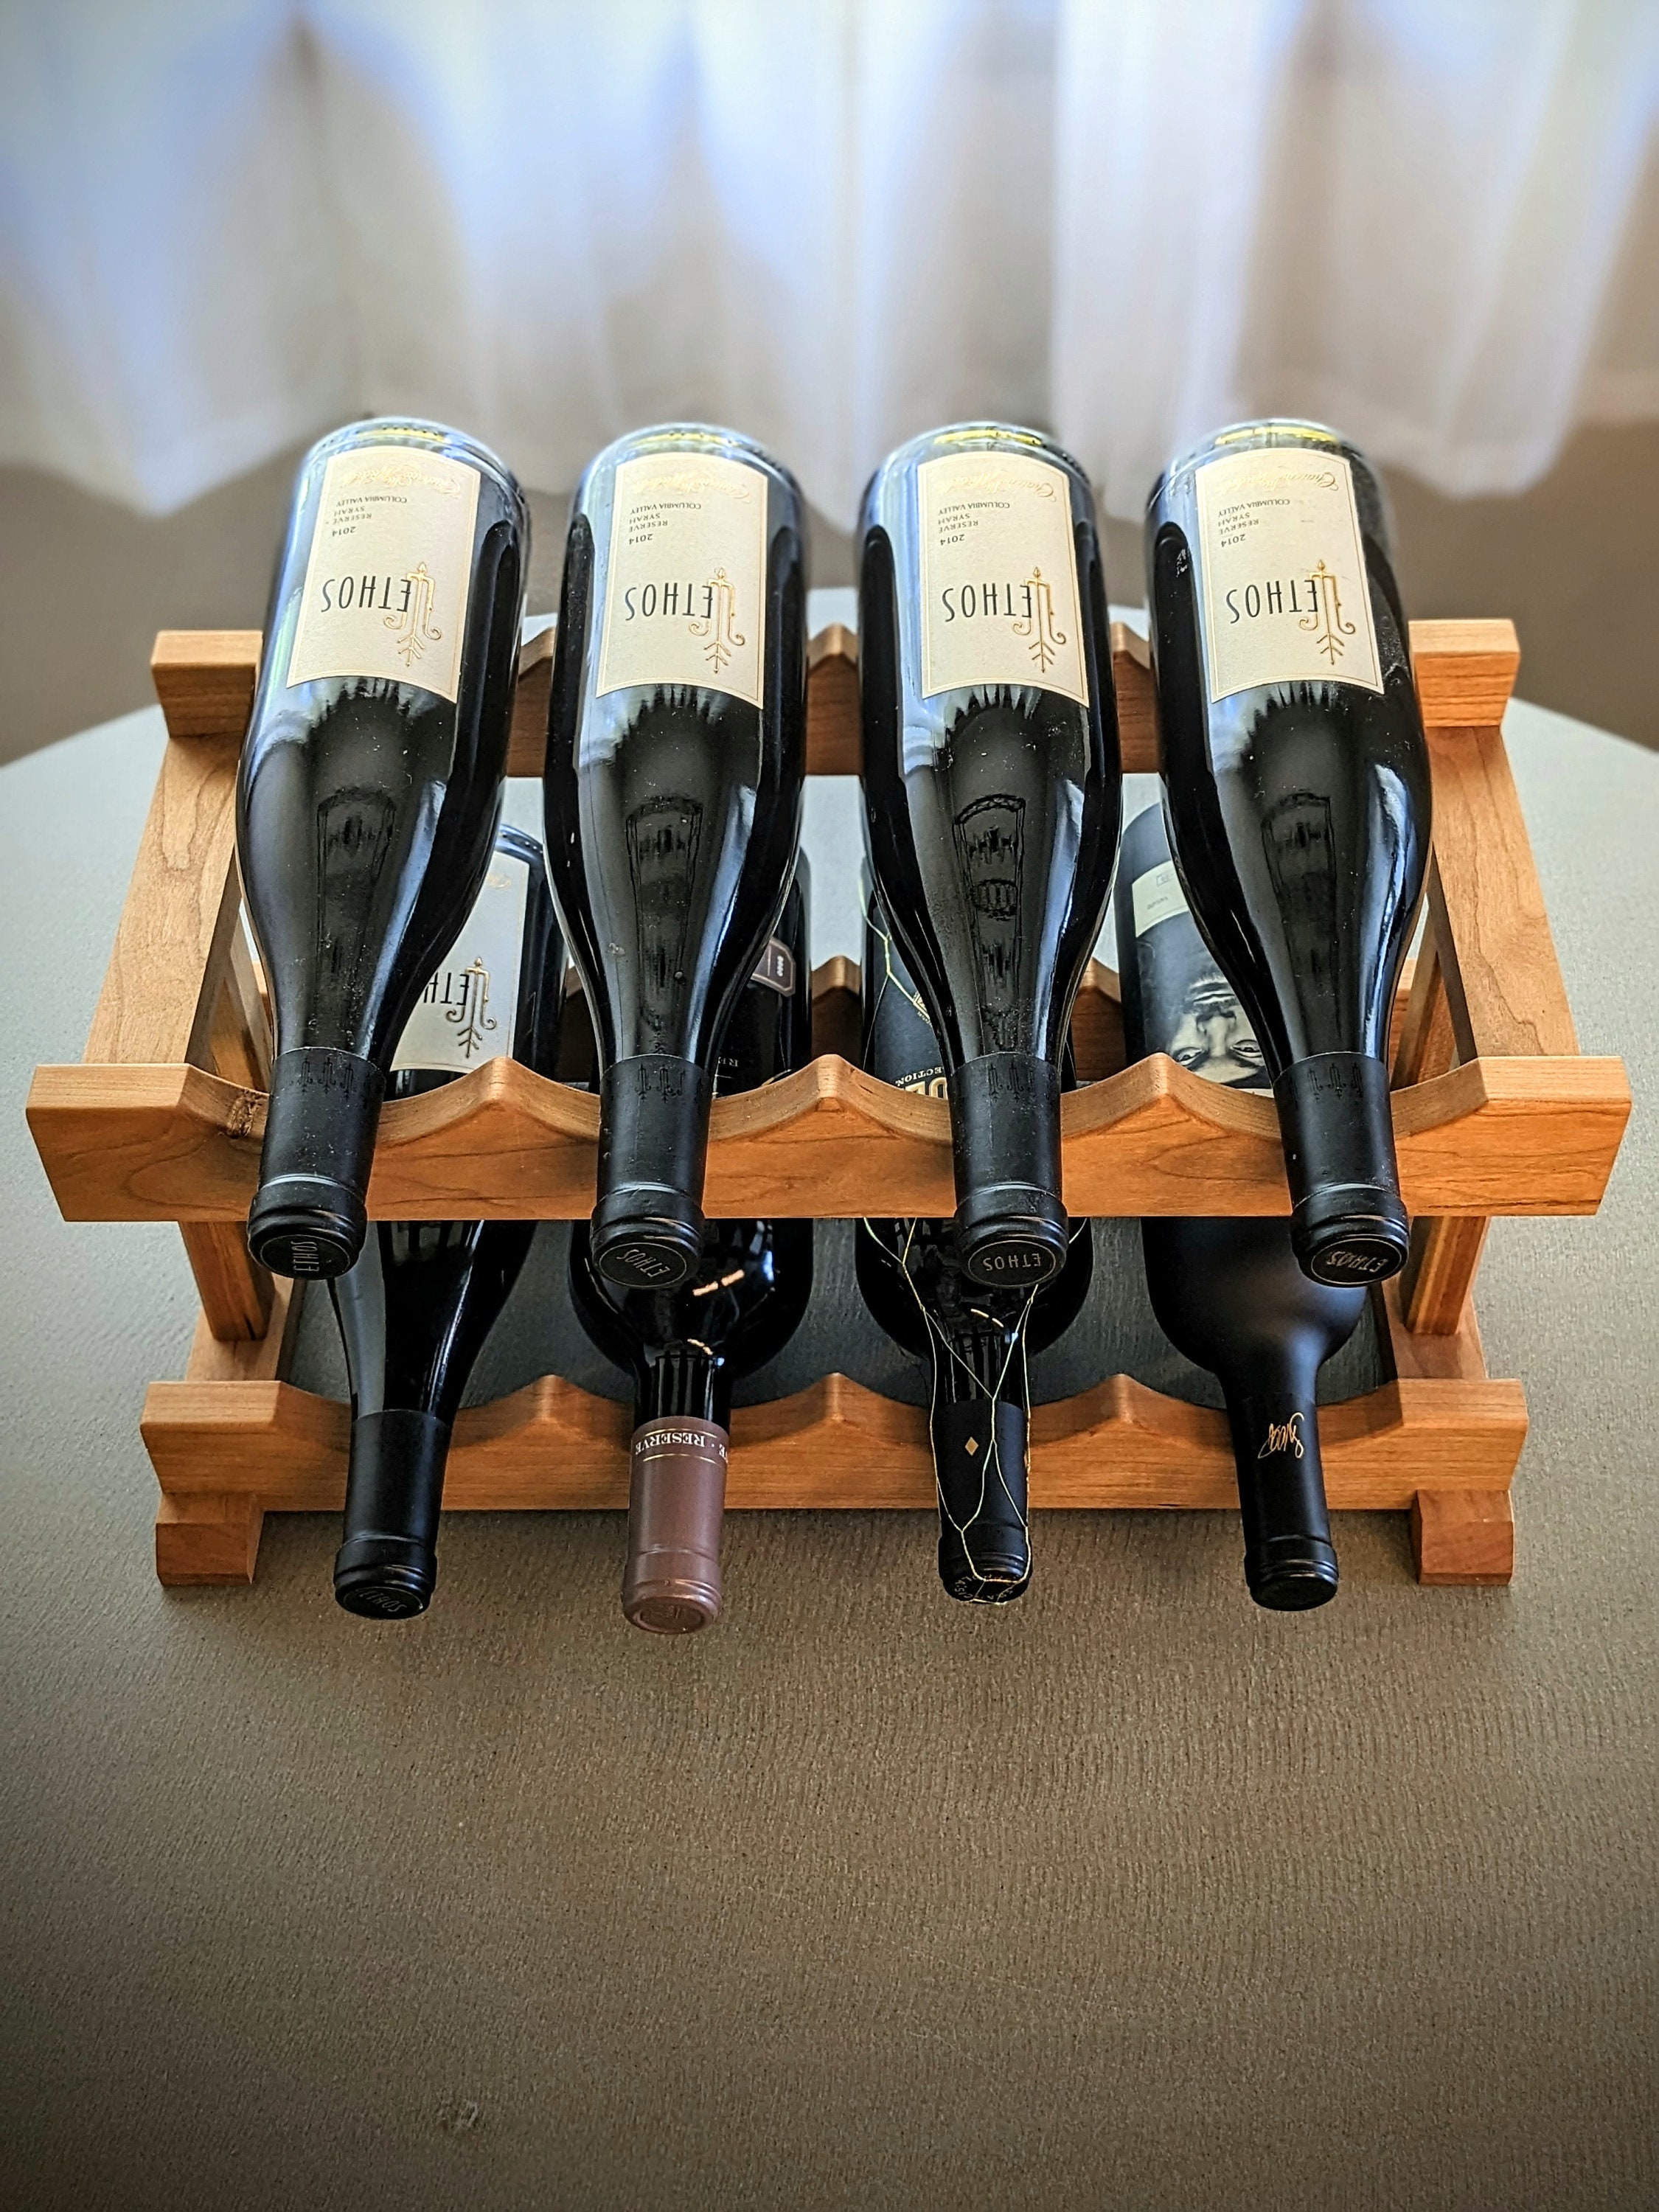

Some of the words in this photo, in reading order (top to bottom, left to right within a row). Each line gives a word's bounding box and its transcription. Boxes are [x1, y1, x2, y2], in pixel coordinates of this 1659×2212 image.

[335, 498, 363, 507] VALLEY
[1248, 499, 1290, 508] COLUMBIA
[333, 507, 365, 516] SYRAH
[630, 504, 656, 514] VALLEY
[937, 504, 966, 515] VALLEY
[1217, 504, 1245, 516] VALLEY
[333, 513, 372, 524] RESERVE
[628, 513, 661, 524] SYRAH
[937, 513, 970, 524] SYRAH
[1217, 512, 1251, 526] SYRAH
[332, 526, 356, 536] 2014
[629, 521, 668, 532] RESERVE
[938, 521, 978, 533] RESERVE
[1218, 520, 1259, 535] RESERVE
[628, 534, 653, 545] 2014
[939, 535, 965, 545] 2014
[1220, 534, 1245, 547] 2014
[321, 575, 411, 613] ETHOS
[625, 582, 713, 621] ETHOS
[942, 582, 1032, 622] ETHOS
[1225, 580, 1318, 625] ETHOS
[423, 972, 470, 1006] ETH
[291, 1240, 320, 1273] ETHOS
[982, 1253, 1041, 1271] ETHOS
[1326, 1251, 1388, 1273] ETHOS
[616, 1248, 671, 1278] ETHOS
[635, 1432, 706, 1455] RESERVE
